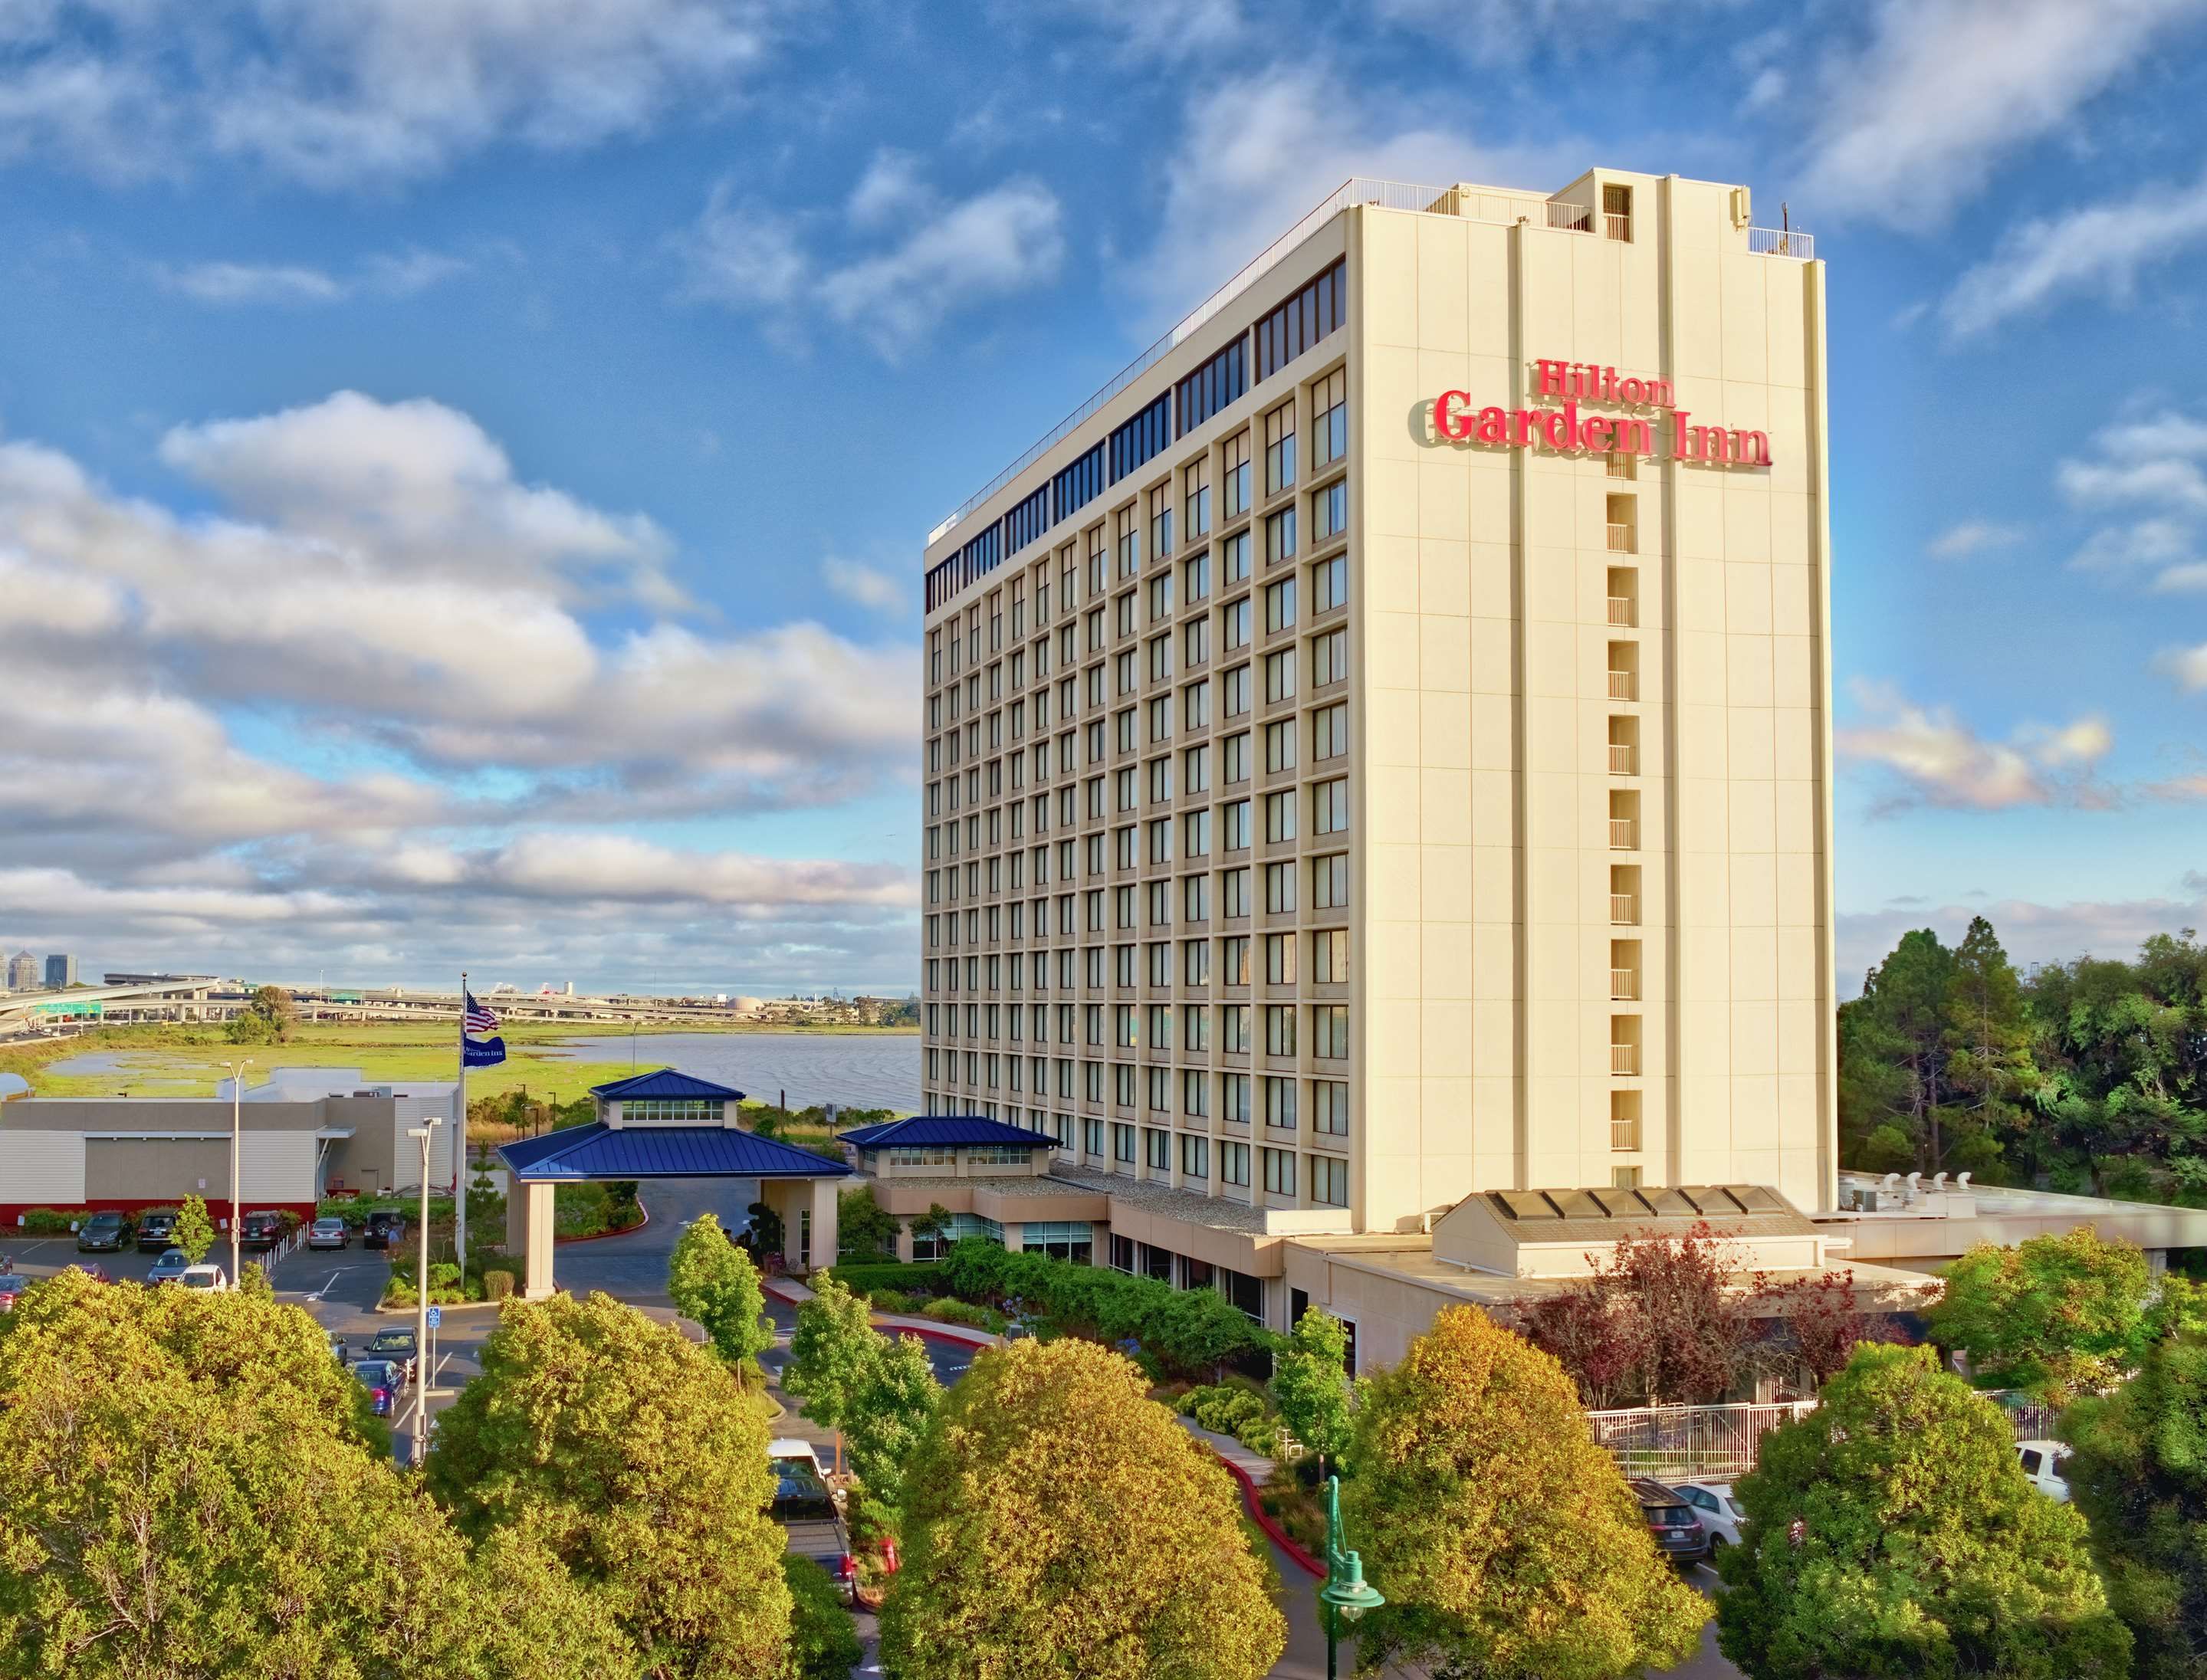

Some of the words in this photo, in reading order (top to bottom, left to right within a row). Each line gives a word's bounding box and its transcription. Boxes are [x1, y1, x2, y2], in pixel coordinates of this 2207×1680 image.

[1535, 359, 1677, 408] Hilton
[1434, 389, 1653, 455] Garden
[1671, 411, 1772, 466] Inn
